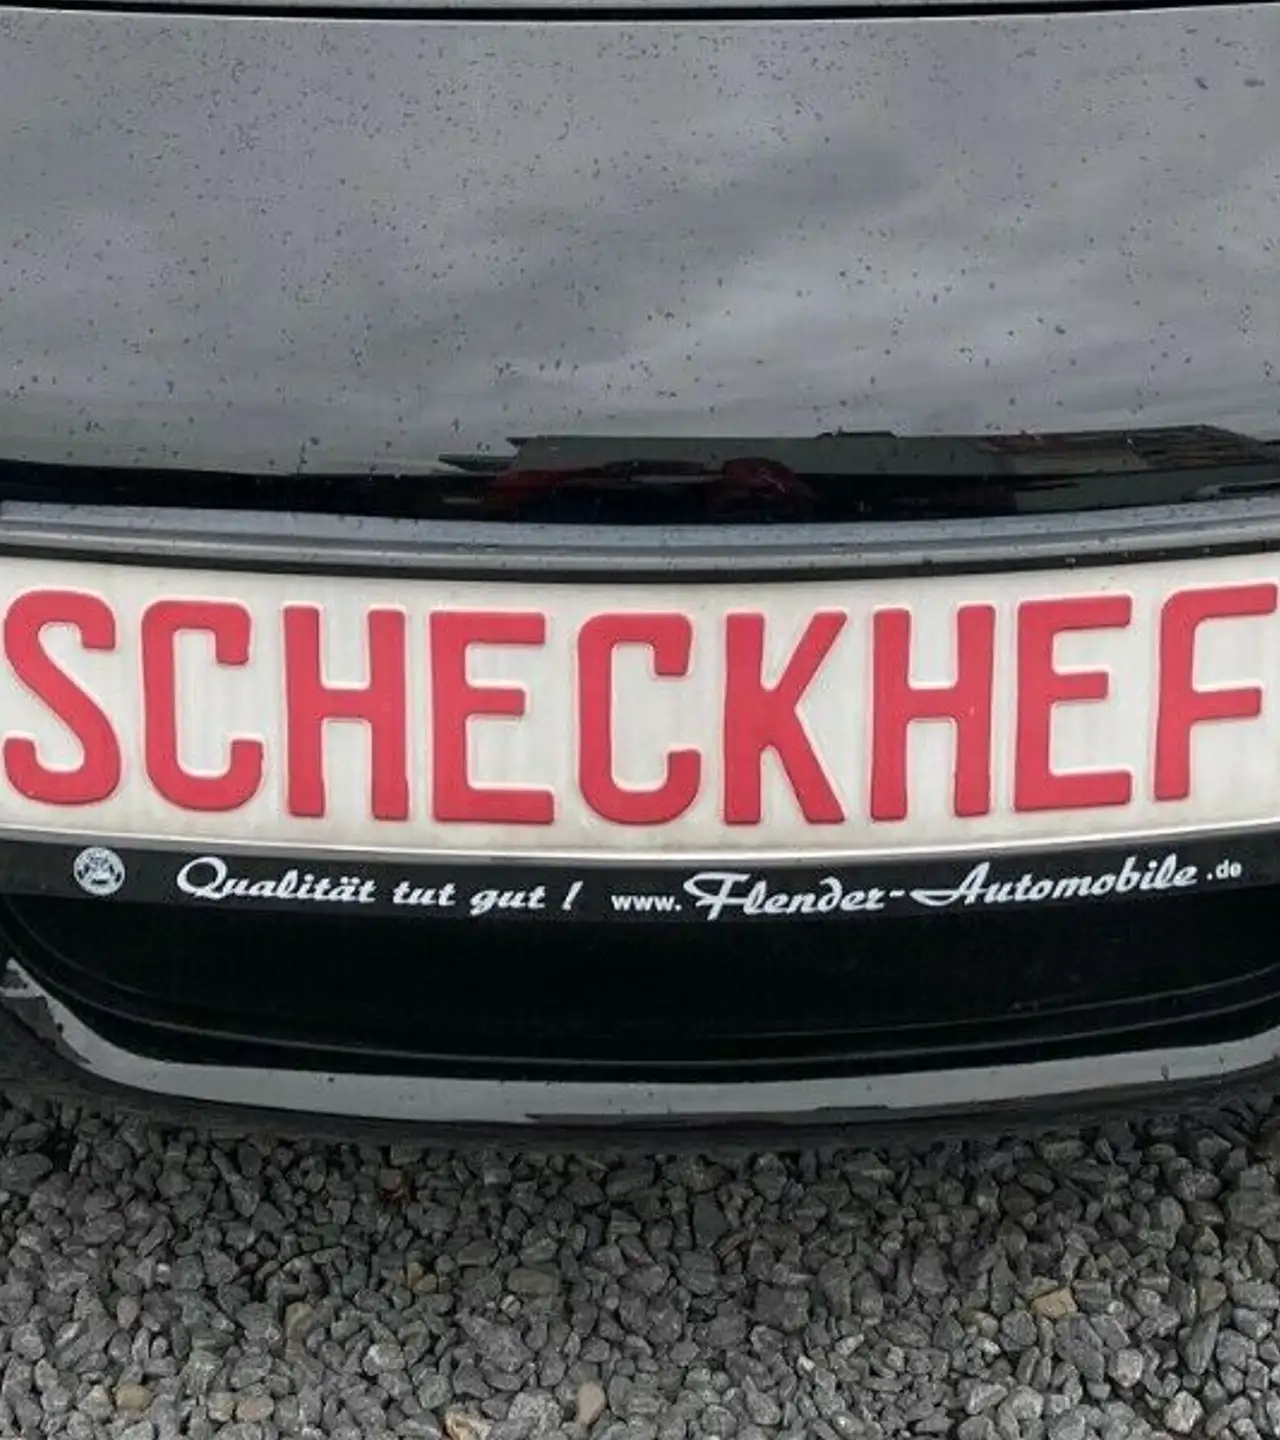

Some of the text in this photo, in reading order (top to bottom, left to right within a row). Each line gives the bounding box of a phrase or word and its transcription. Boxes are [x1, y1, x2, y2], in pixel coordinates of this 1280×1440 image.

[176, 856, 376, 902] Qualität
[393, 880, 455, 908] tut
[470, 882, 546, 917] gut
